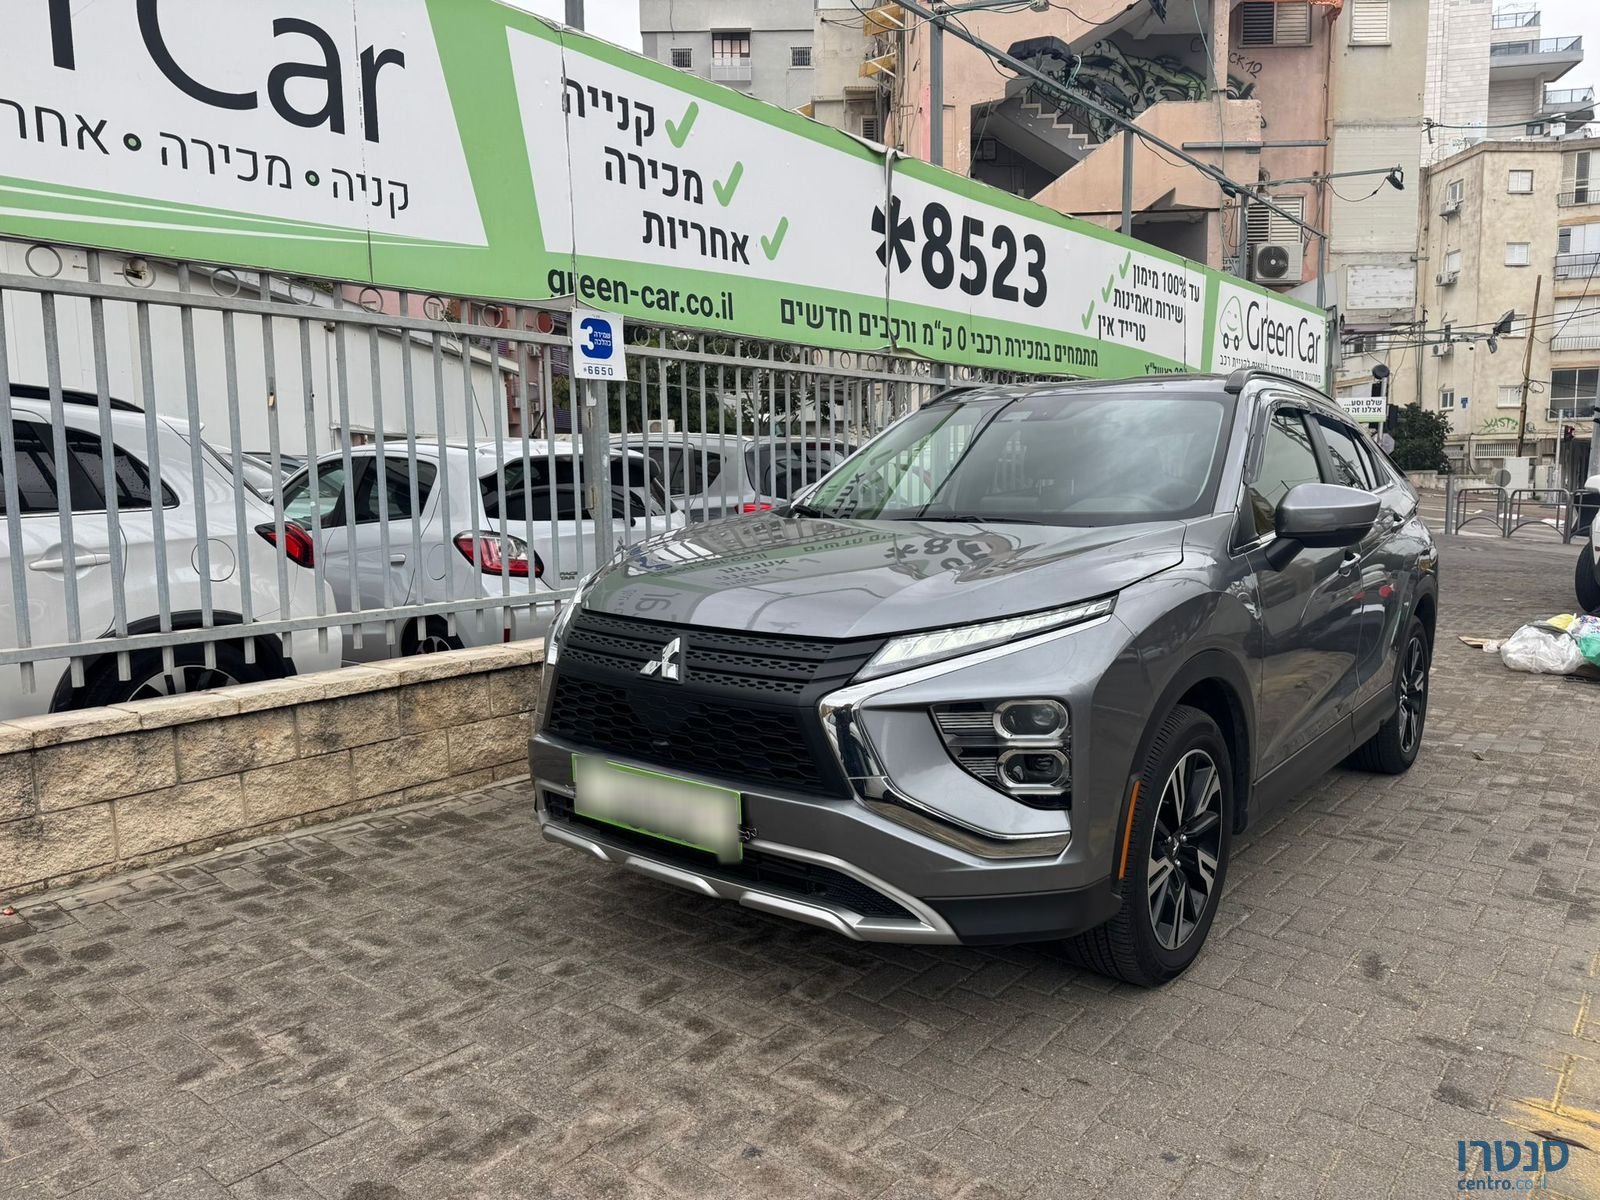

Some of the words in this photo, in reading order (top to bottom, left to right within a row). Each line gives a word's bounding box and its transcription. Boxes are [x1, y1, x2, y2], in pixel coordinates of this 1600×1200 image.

[561, 76, 655, 147] קנייה
[160, 131, 292, 190] מכירה
[604, 146, 703, 205] מכירה
[332, 168, 409, 219] קניה
[642, 210, 750, 265] אחריות
[1133, 264, 1159, 289] מימון
[1162, 272, 1186, 298] 100%
[547, 268, 734, 320] green-car.co.il
[1113, 288, 1152, 316] ואמינות
[1188, 283, 1200, 302] עד
[780, 298, 852, 334] חדשים
[1155, 300, 1183, 323] שירות
[859, 312, 916, 343] ורכבים
[957, 325, 966, 350] 0
[1098, 314, 1115, 340] אין
[1117, 319, 1146, 342] טרייד
[1246, 301, 1294, 359] Green
[1298, 318, 1320, 365] Car
[971, 332, 1001, 355] רכבי
[1005, 337, 1051, 361] במכירת
[1054, 344, 1098, 367] מתמחים
